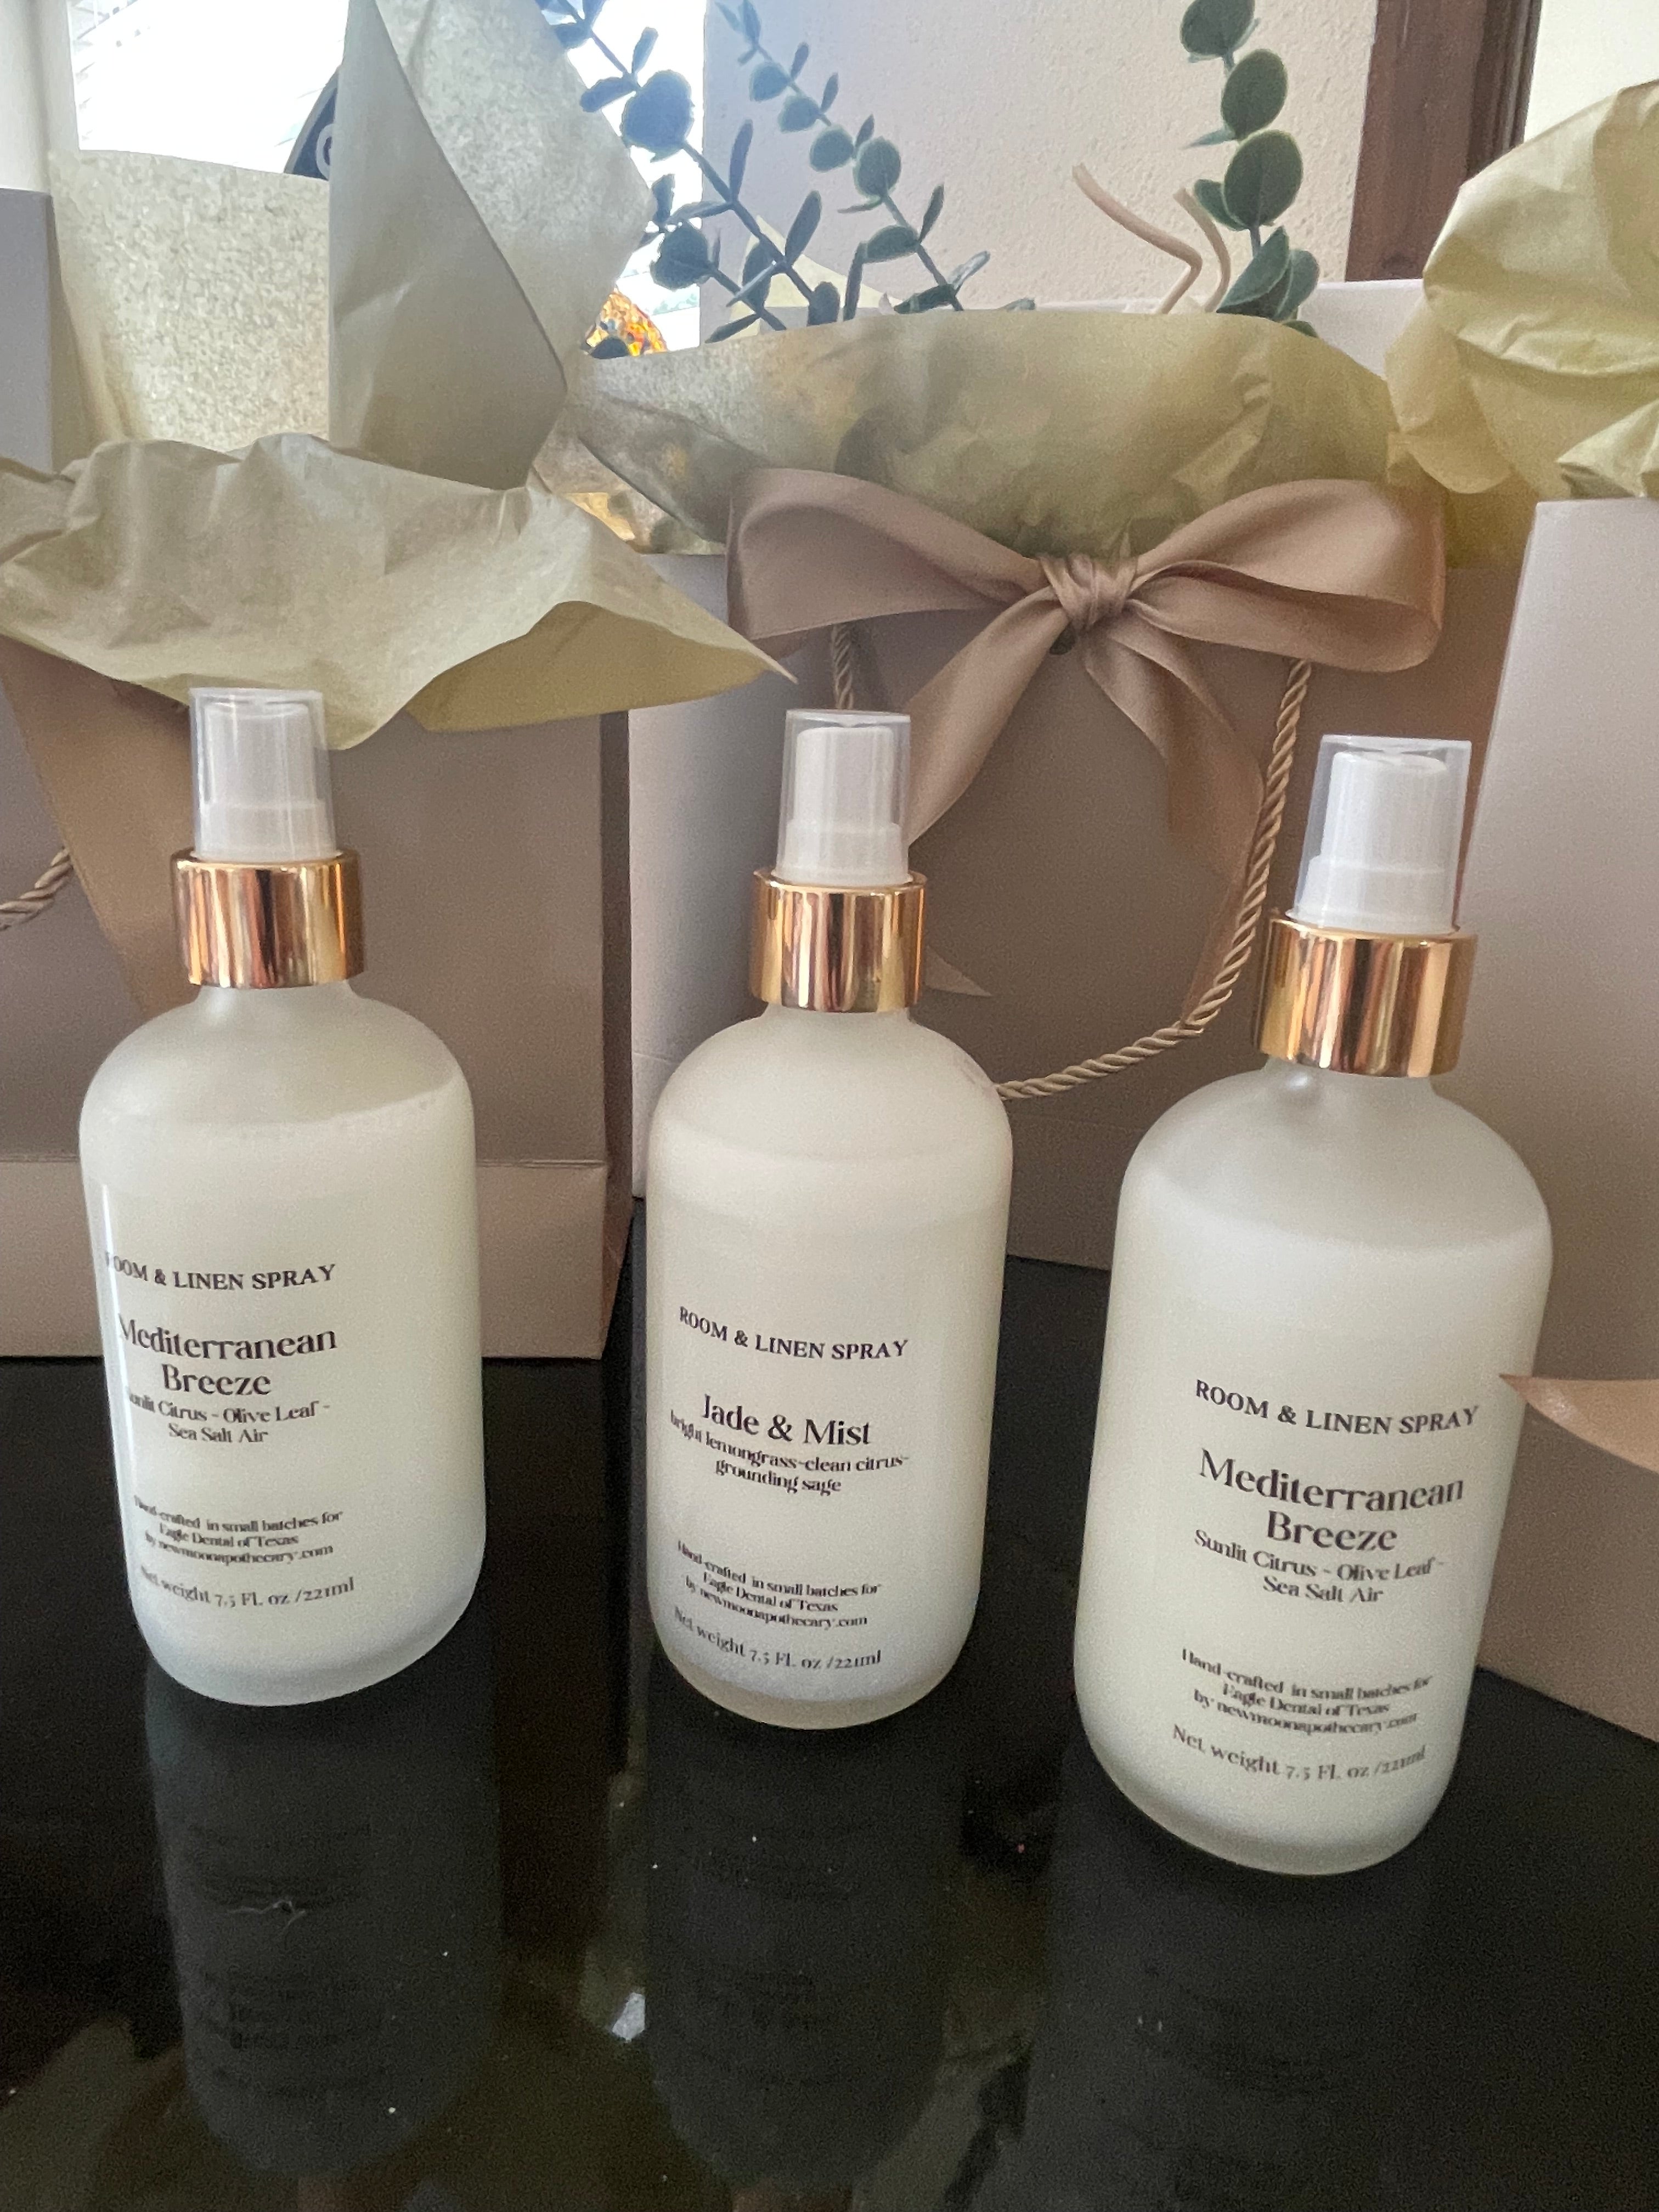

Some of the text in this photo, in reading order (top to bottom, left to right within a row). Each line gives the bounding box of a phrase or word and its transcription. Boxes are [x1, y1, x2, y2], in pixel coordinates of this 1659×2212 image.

[155, 1269, 167, 1286] &
[172, 1271, 244, 1290] LINEN
[252, 1264, 336, 1290] SPRAY
[118, 1313, 337, 1359] Mediterranean
[680, 1306, 909, 1359] ROOM & LINEN SPRAY
[162, 1363, 272, 1396] Breeze
[158, 1401, 207, 1421] Citrus
[223, 1408, 271, 1423] Olive
[275, 1400, 319, 1423] Leaf
[702, 1394, 871, 1445] Jade & Mist
[1196, 1379, 1480, 1435] ROOM & LINEN SPRAY
[168, 1423, 269, 1443] Sea Salt Air
[715, 1459, 842, 1497] grounding sage
[1199, 1447, 1464, 1513] Mediterranean
[159, 1522, 299, 1548] Eagle Dental of Texas
[206, 1519, 219, 1531] in
[222, 1521, 258, 1532] small
[262, 1516, 318, 1531] batches
[321, 1511, 343, 1524] for
[1267, 1510, 1398, 1552] Breeze
[1194, 1528, 1248, 1564] Sunlit
[1252, 1550, 1317, 1577] Citrus
[1336, 1562, 1390, 1582] Olive
[1395, 1557, 1437, 1580] Leaf
[161, 1579, 211, 1604] weight
[215, 1594, 236, 1607] 7.5
[268, 1594, 290, 1606] oz
[703, 1571, 838, 1612] Eagle Dental of Texas
[752, 1576, 764, 1589] in
[767, 1582, 803, 1596] small
[806, 1584, 858, 1598] batches
[861, 1583, 882, 1596] for
[1263, 1575, 1385, 1604] Sea Salt Air
[674, 1605, 693, 1632] Net
[697, 1626, 746, 1657] weight
[750, 1650, 770, 1664] 7.5
[802, 1658, 822, 1669] oz
[1193, 1688, 1214, 1709] by
[1223, 1683, 1391, 1717] Eagle Dental of Texas
[1291, 1683, 1307, 1698] in
[1311, 1688, 1354, 1700] small
[1358, 1683, 1410, 1700] batches
[1172, 1723, 1206, 1753] Net
[1211, 1744, 1281, 1775] weight
[1286, 1764, 1311, 1780] 7.5
[1347, 1766, 1369, 1778] oz
